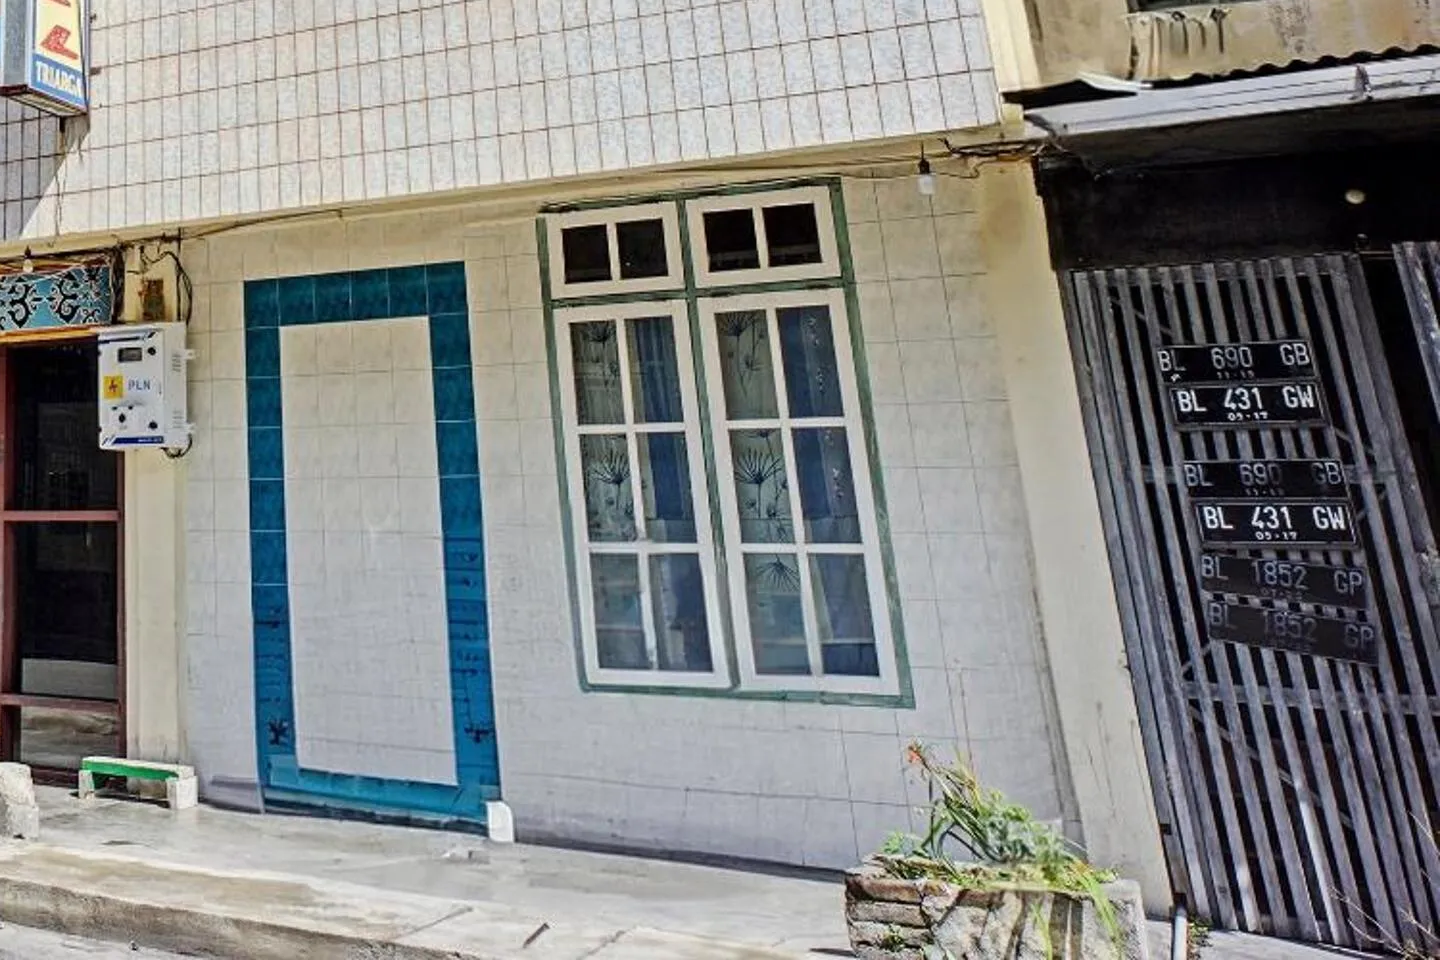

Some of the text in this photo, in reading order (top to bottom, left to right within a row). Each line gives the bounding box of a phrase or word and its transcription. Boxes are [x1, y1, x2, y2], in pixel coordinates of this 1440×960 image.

[35, 60, 82, 99] TRIARGA
[1158, 343, 1311, 373] BL 690 GB
[127, 379, 151, 390] PLN
[1176, 386, 1316, 413] BL 431 GW
[1184, 462, 1344, 487] BL 690 GB
[1203, 506, 1347, 530] BL 431 GW
[1200, 555, 1229, 581] BL
[1250, 559, 1310, 590] 1852
[1333, 570, 1363, 596] GP
[1209, 602, 1239, 631] BL
[1263, 609, 1319, 642] 1852
[1344, 622, 1375, 649] GP
